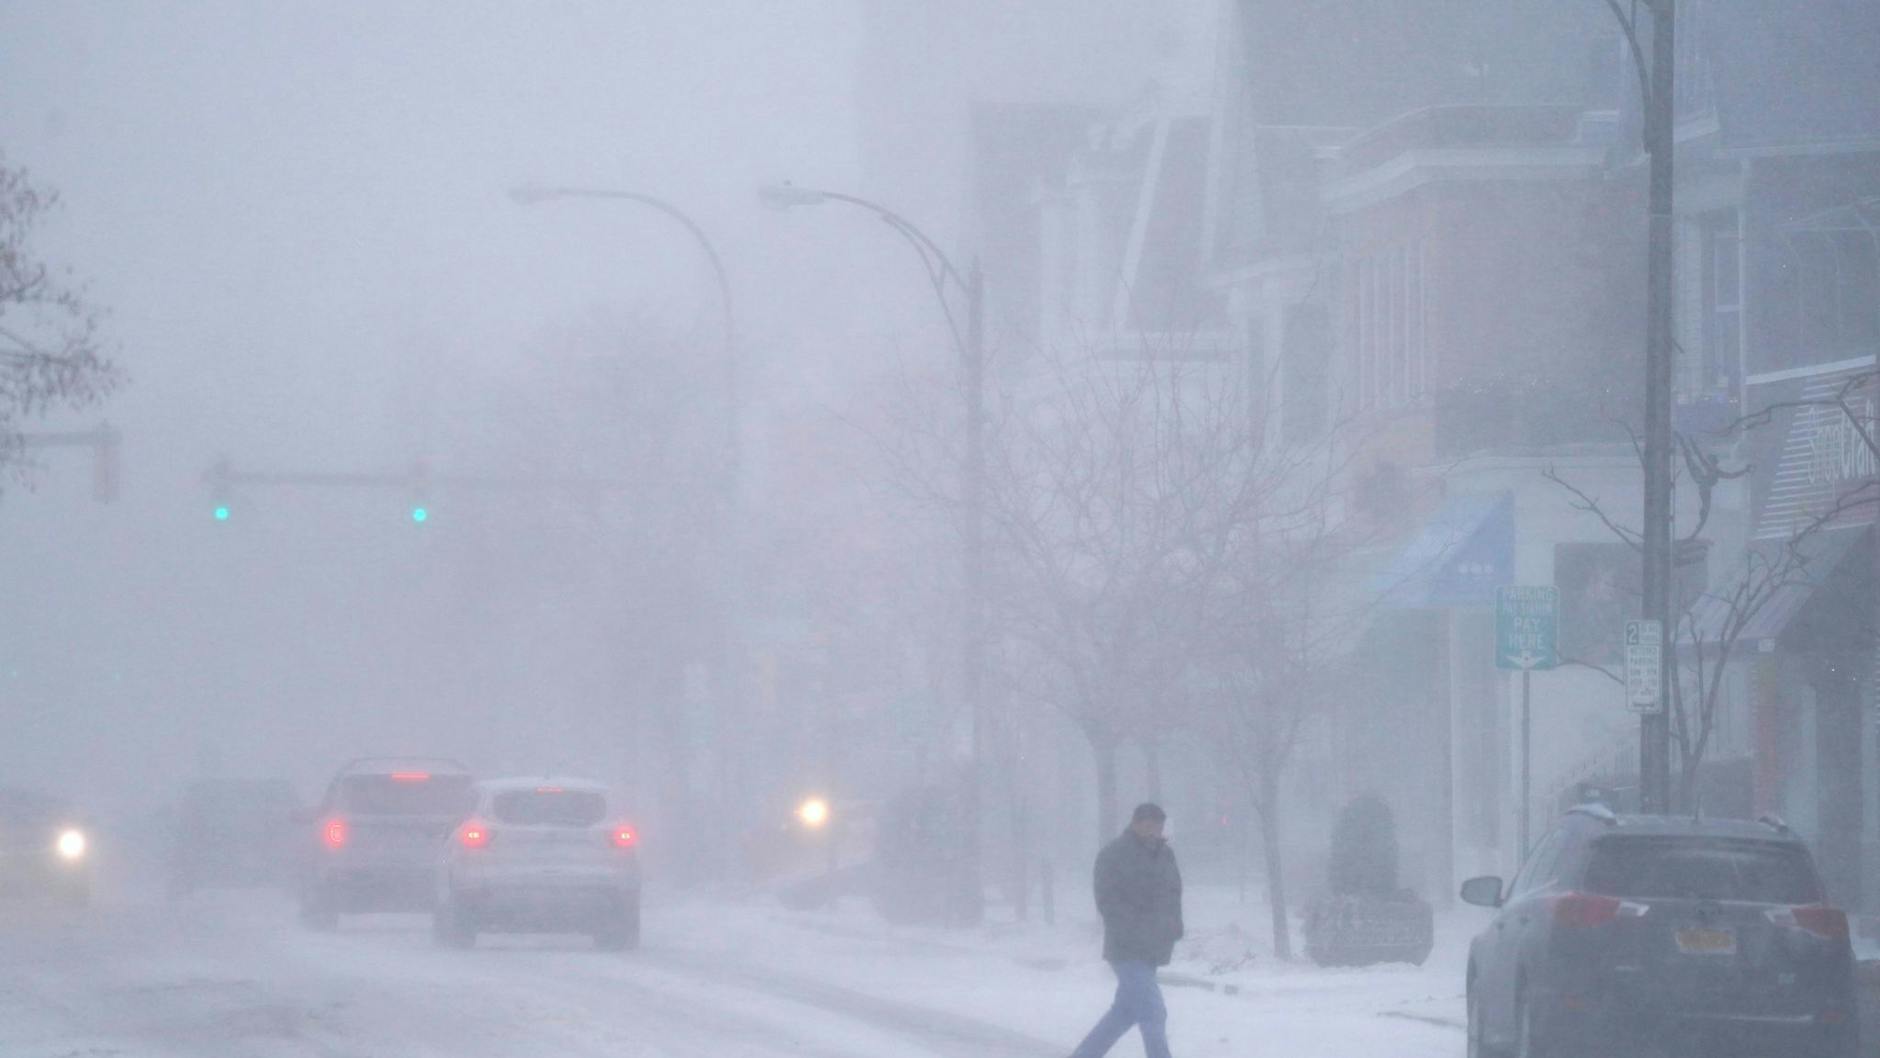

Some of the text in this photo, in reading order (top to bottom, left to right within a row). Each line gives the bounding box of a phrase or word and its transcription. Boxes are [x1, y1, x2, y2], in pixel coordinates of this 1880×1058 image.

[1513, 616, 1541, 632] PAY
[1508, 633, 1545, 649] HERE
[1628, 624, 1638, 643] 2
